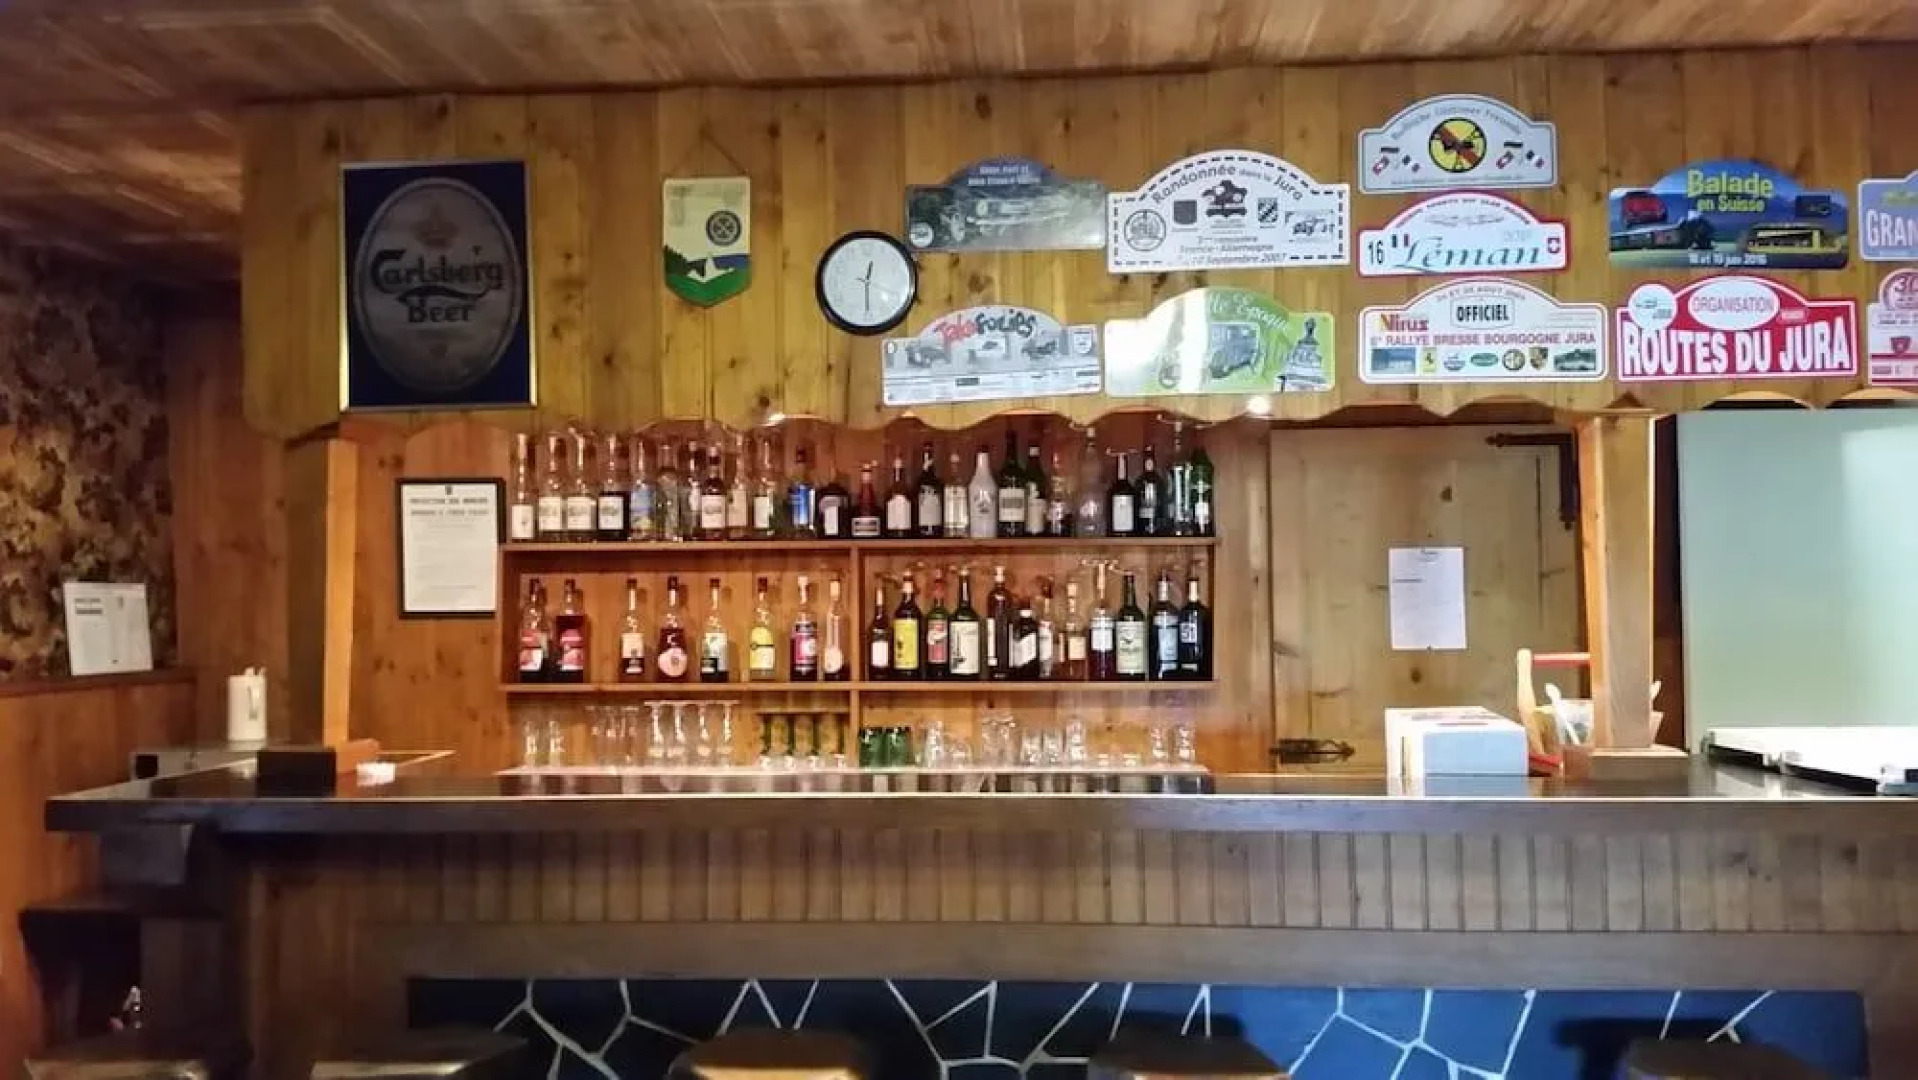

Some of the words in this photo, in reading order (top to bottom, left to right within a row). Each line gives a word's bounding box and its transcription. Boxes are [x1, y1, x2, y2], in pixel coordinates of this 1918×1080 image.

[1152, 166, 1237, 204] Randonnée
[1273, 174, 1304, 201] Jura
[1687, 168, 1774, 199] Balade
[1696, 198, 1714, 211] en
[1718, 196, 1766, 212] Suisse
[1367, 240, 1385, 266] 16
[1393, 236, 1541, 273] Léman
[371, 247, 505, 297] Carlsberg
[407, 298, 474, 324] Beer
[1456, 304, 1509, 322] OFFICIEL
[1691, 296, 1774, 313] ORGANISATION
[1386, 334, 1430, 346] RALLYE
[1433, 334, 1481, 346] BRESSE
[1484, 333, 1561, 345] BOURGOGNE
[1565, 332, 1597, 344] JURA
[1622, 320, 1729, 375] ROUTES
[1734, 330, 1773, 373] DU
[1779, 316, 1850, 372] JURA
